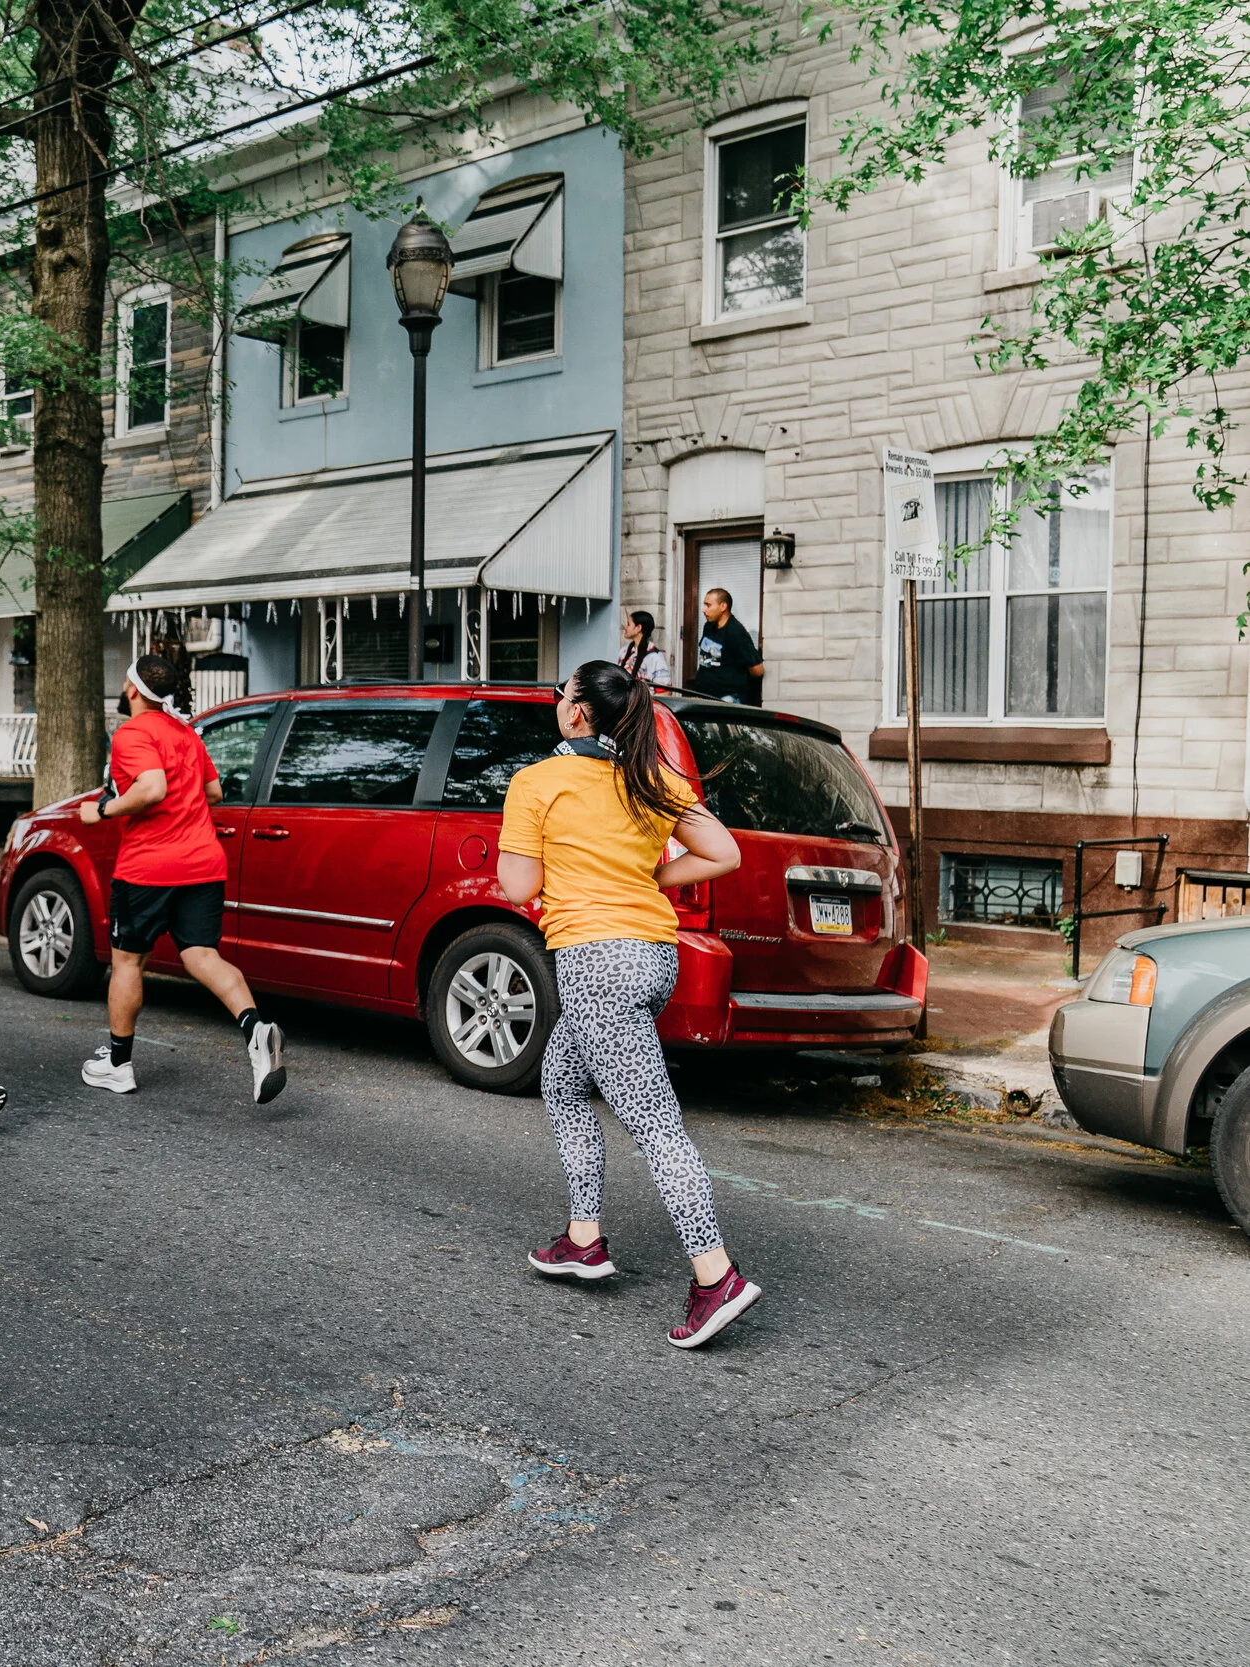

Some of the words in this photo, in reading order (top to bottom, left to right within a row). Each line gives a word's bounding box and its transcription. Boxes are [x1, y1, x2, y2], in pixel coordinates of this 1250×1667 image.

[888, 450, 903, 463] Remain
[885, 462, 903, 475] Rewards
[894, 551, 905, 562] Call
[906, 552, 916, 564] Toll
